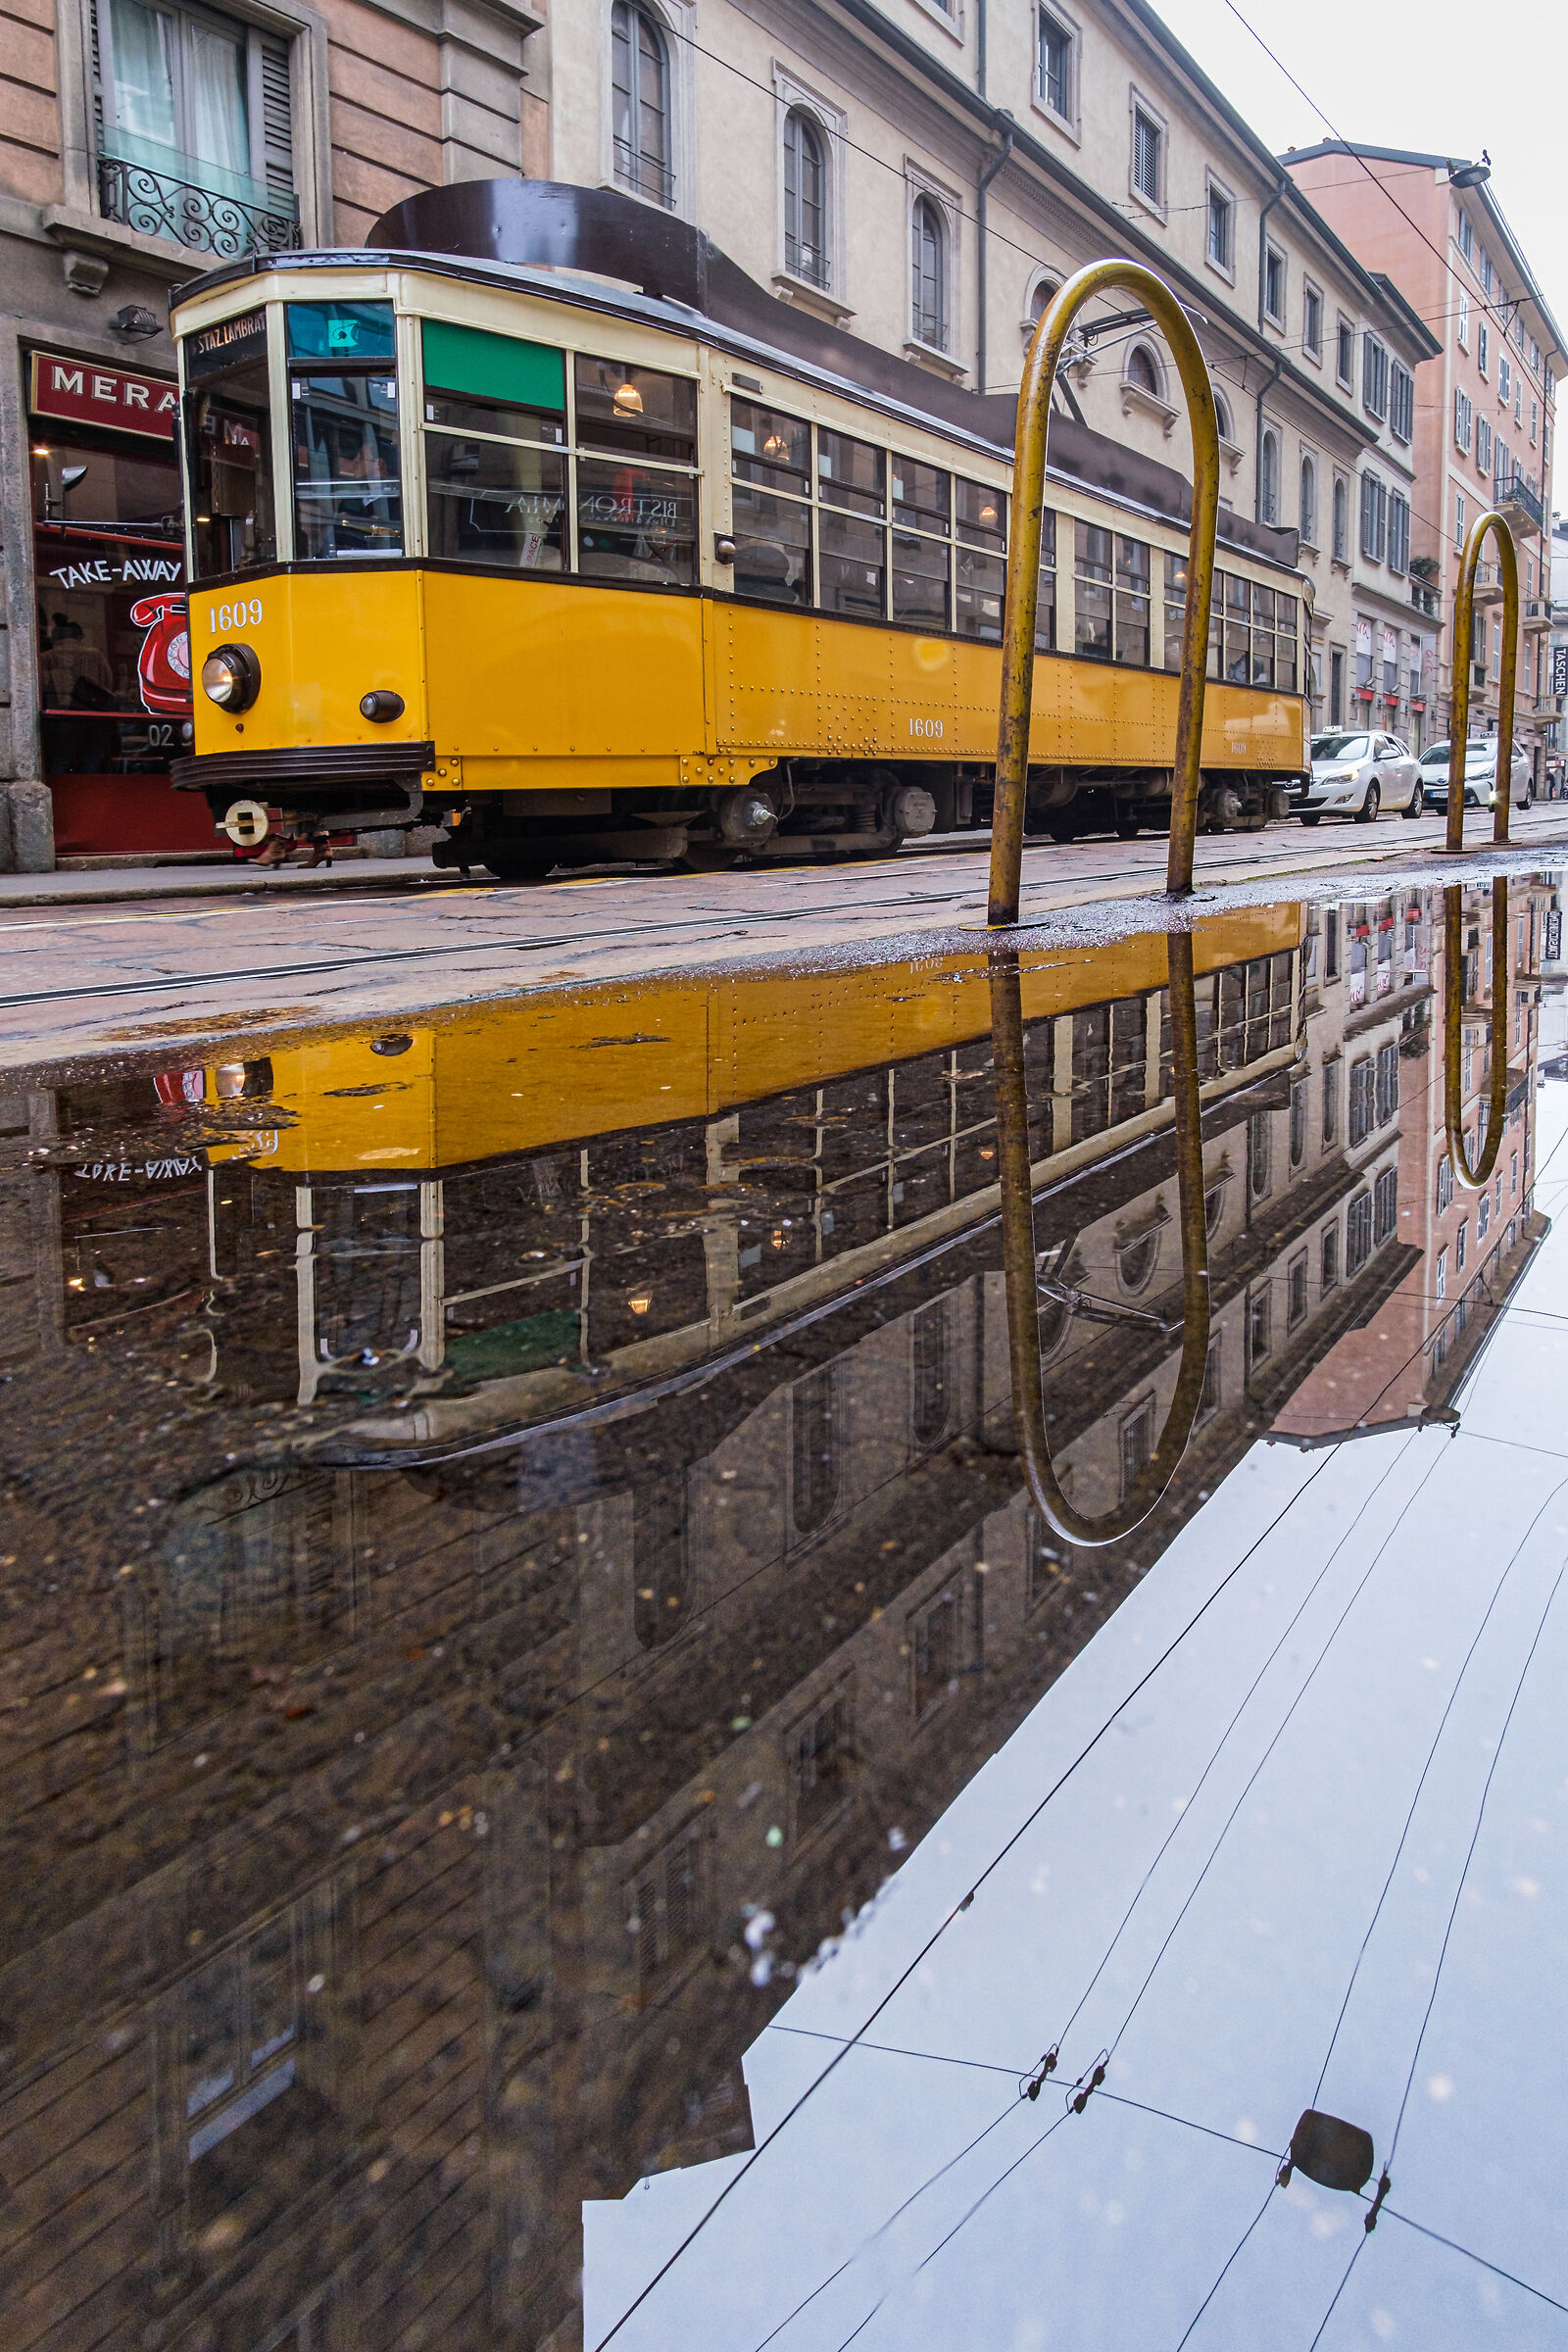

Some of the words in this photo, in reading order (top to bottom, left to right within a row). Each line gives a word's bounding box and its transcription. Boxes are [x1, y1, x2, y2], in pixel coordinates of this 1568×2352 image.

[52, 366, 175, 413] MERA
[49, 559, 182, 589] TAKE-AWAY
[210, 598, 263, 633] 1609
[1555, 648, 1566, 695] TASCHEN
[149, 724, 174, 747] 02
[908, 717, 944, 738] 1609
